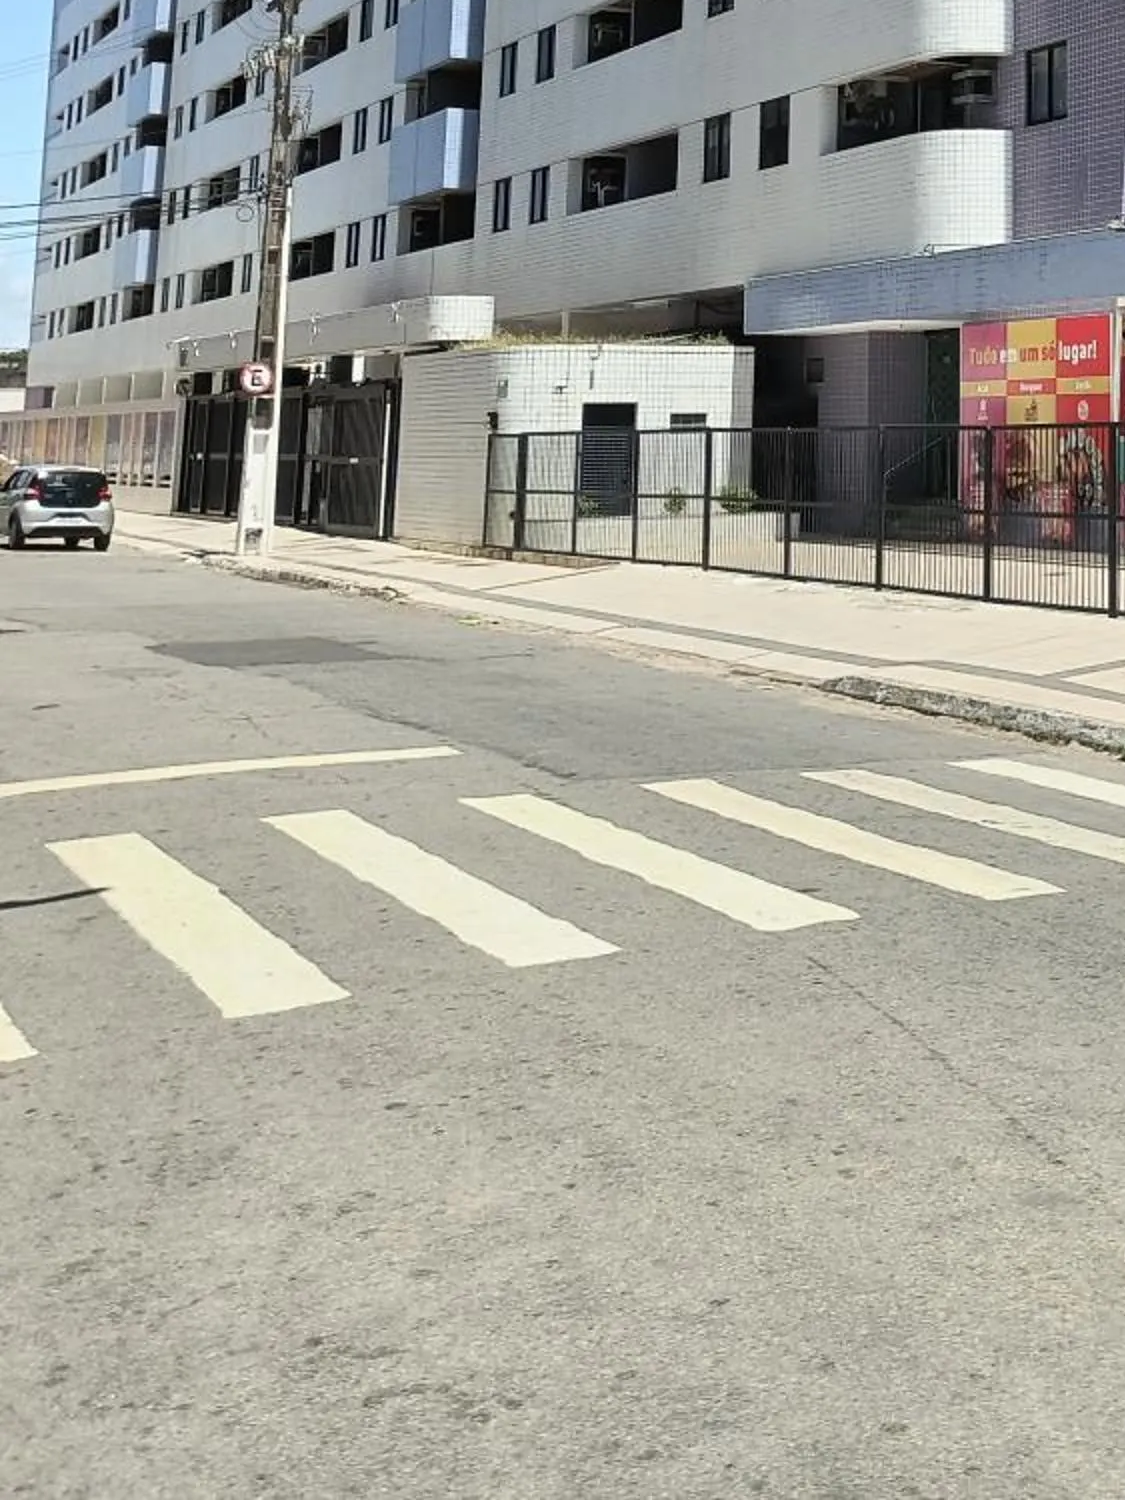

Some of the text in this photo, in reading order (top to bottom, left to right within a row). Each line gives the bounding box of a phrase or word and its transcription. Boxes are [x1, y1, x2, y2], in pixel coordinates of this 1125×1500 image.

[969, 346, 997, 365] Tudo
[1000, 348, 1017, 363] em
[1020, 347, 1039, 362] um
[1058, 339, 1097, 365] lugar!
